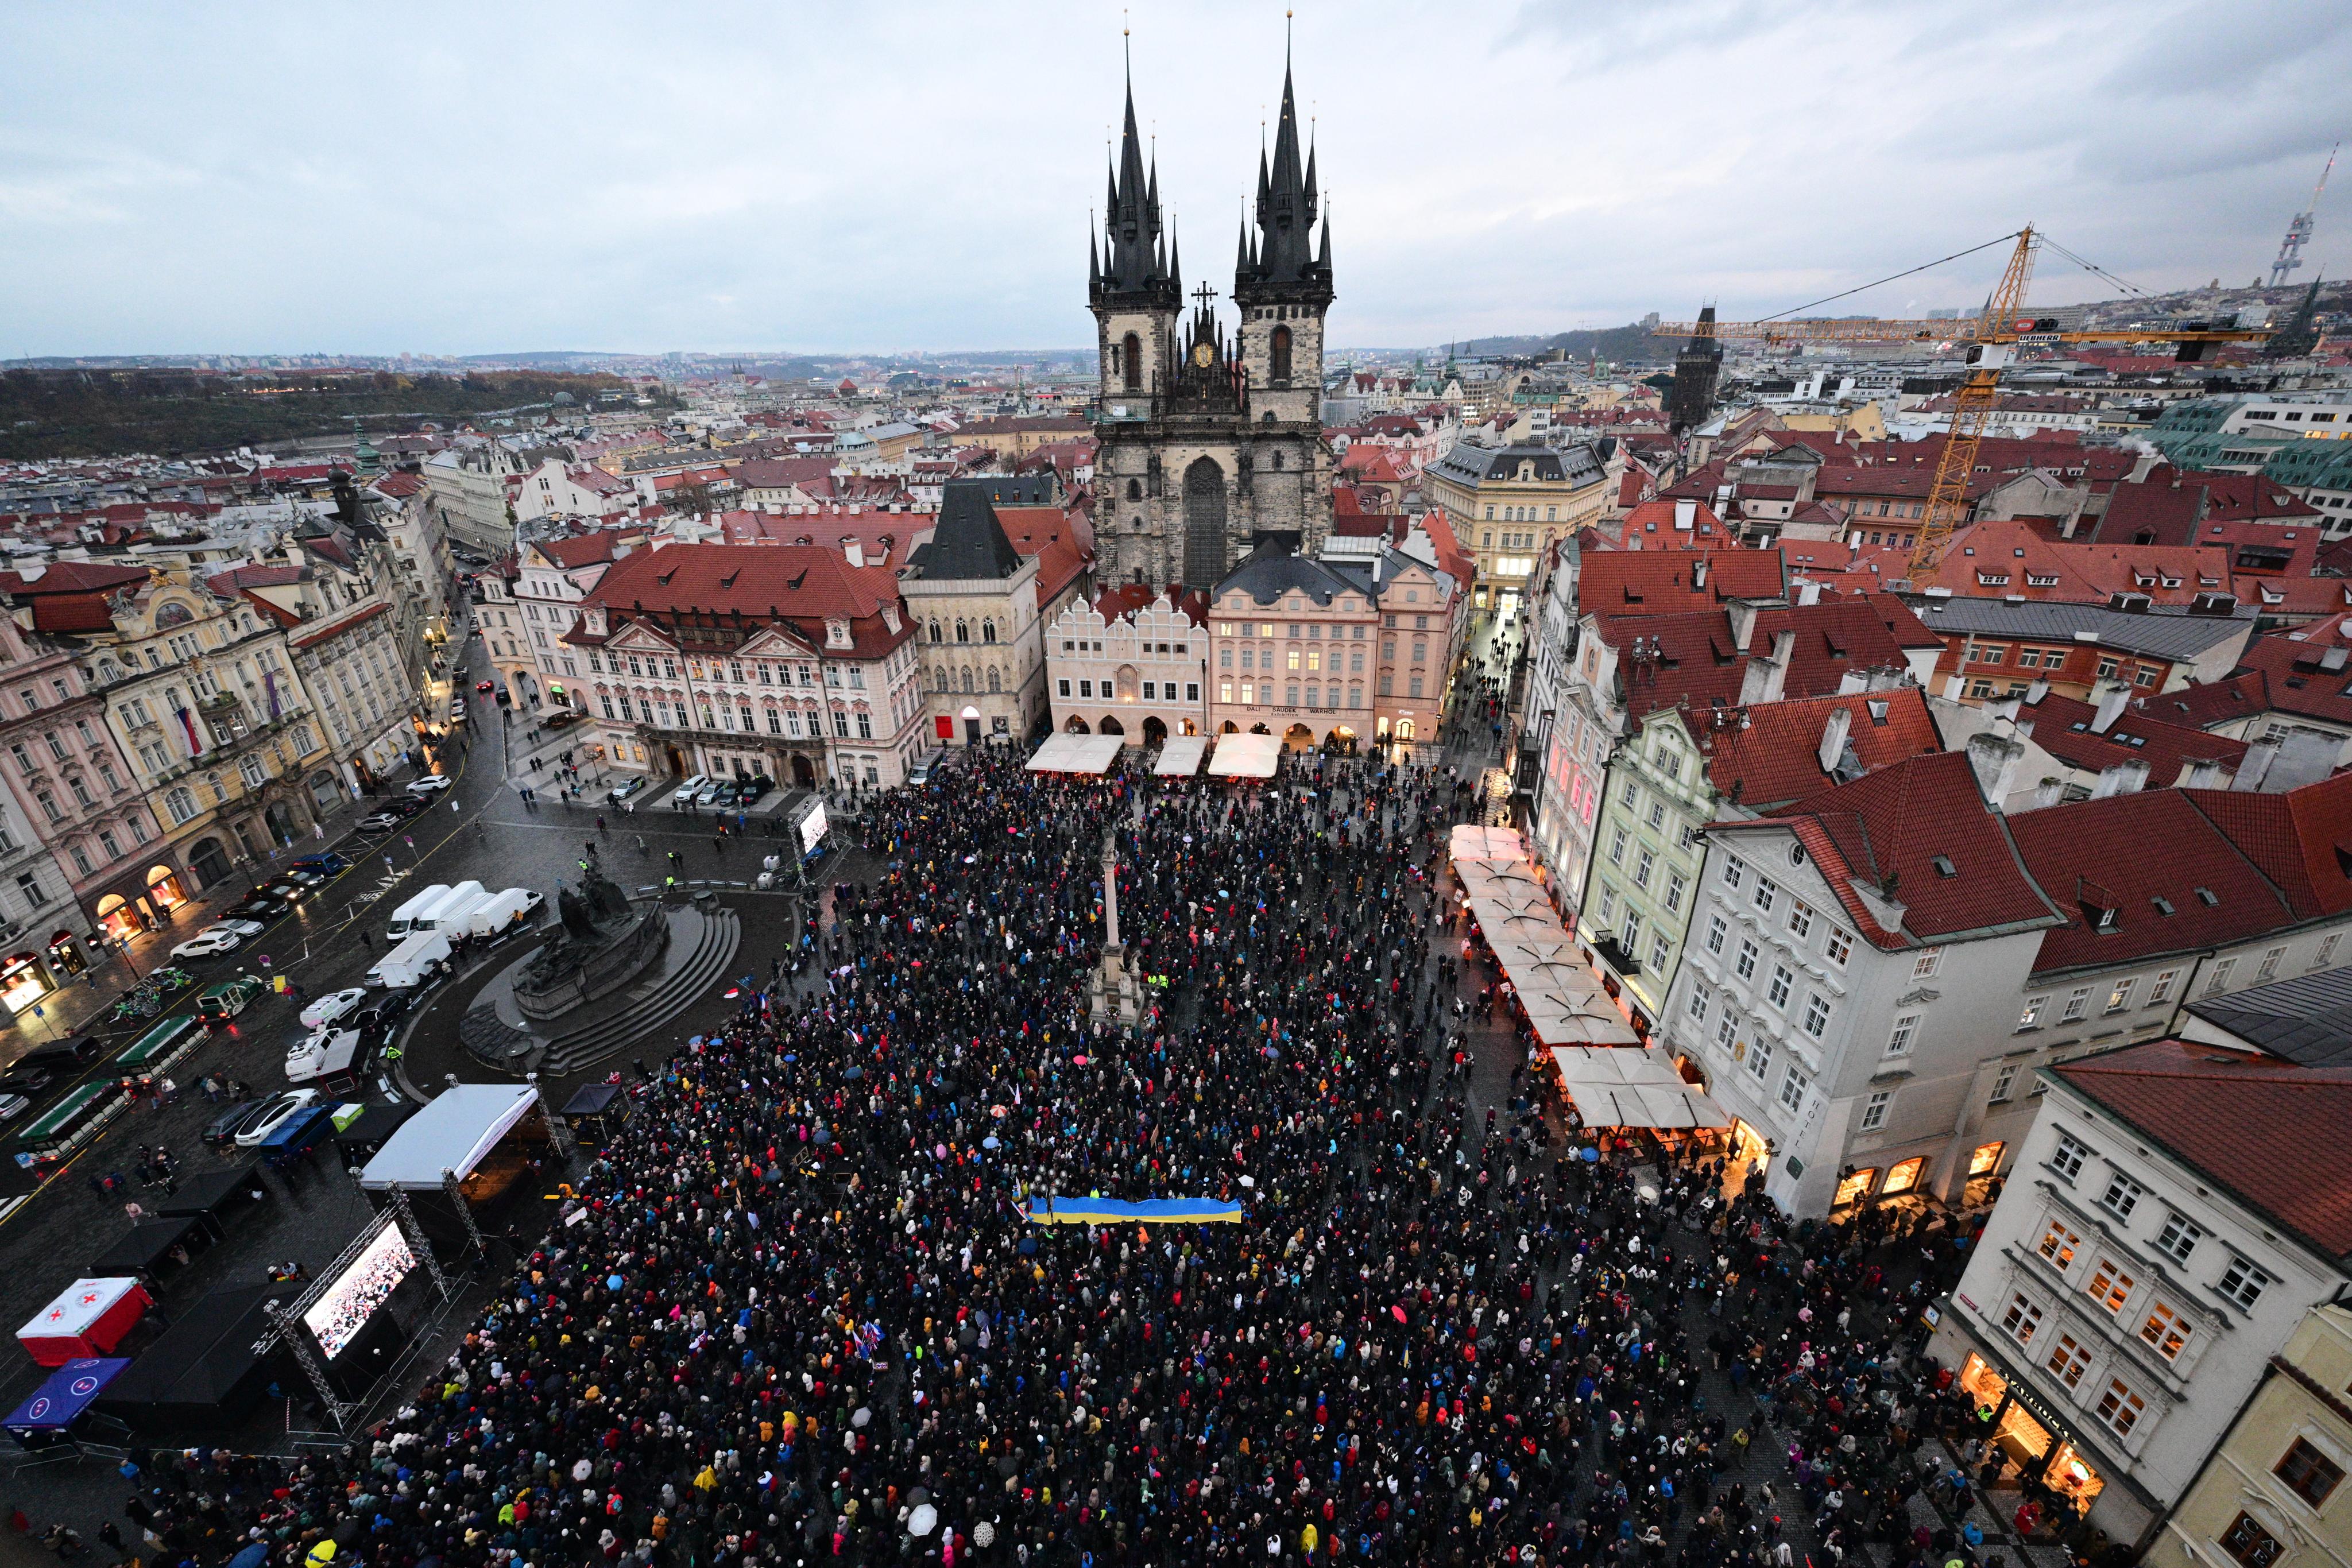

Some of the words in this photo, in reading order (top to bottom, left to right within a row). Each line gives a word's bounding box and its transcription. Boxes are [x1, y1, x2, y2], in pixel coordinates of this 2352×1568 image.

[354, 892, 384, 901] BUS
[1795, 1100, 1820, 1149] HOTEL
[1998, 1368, 2076, 1445] STARBUCKS
